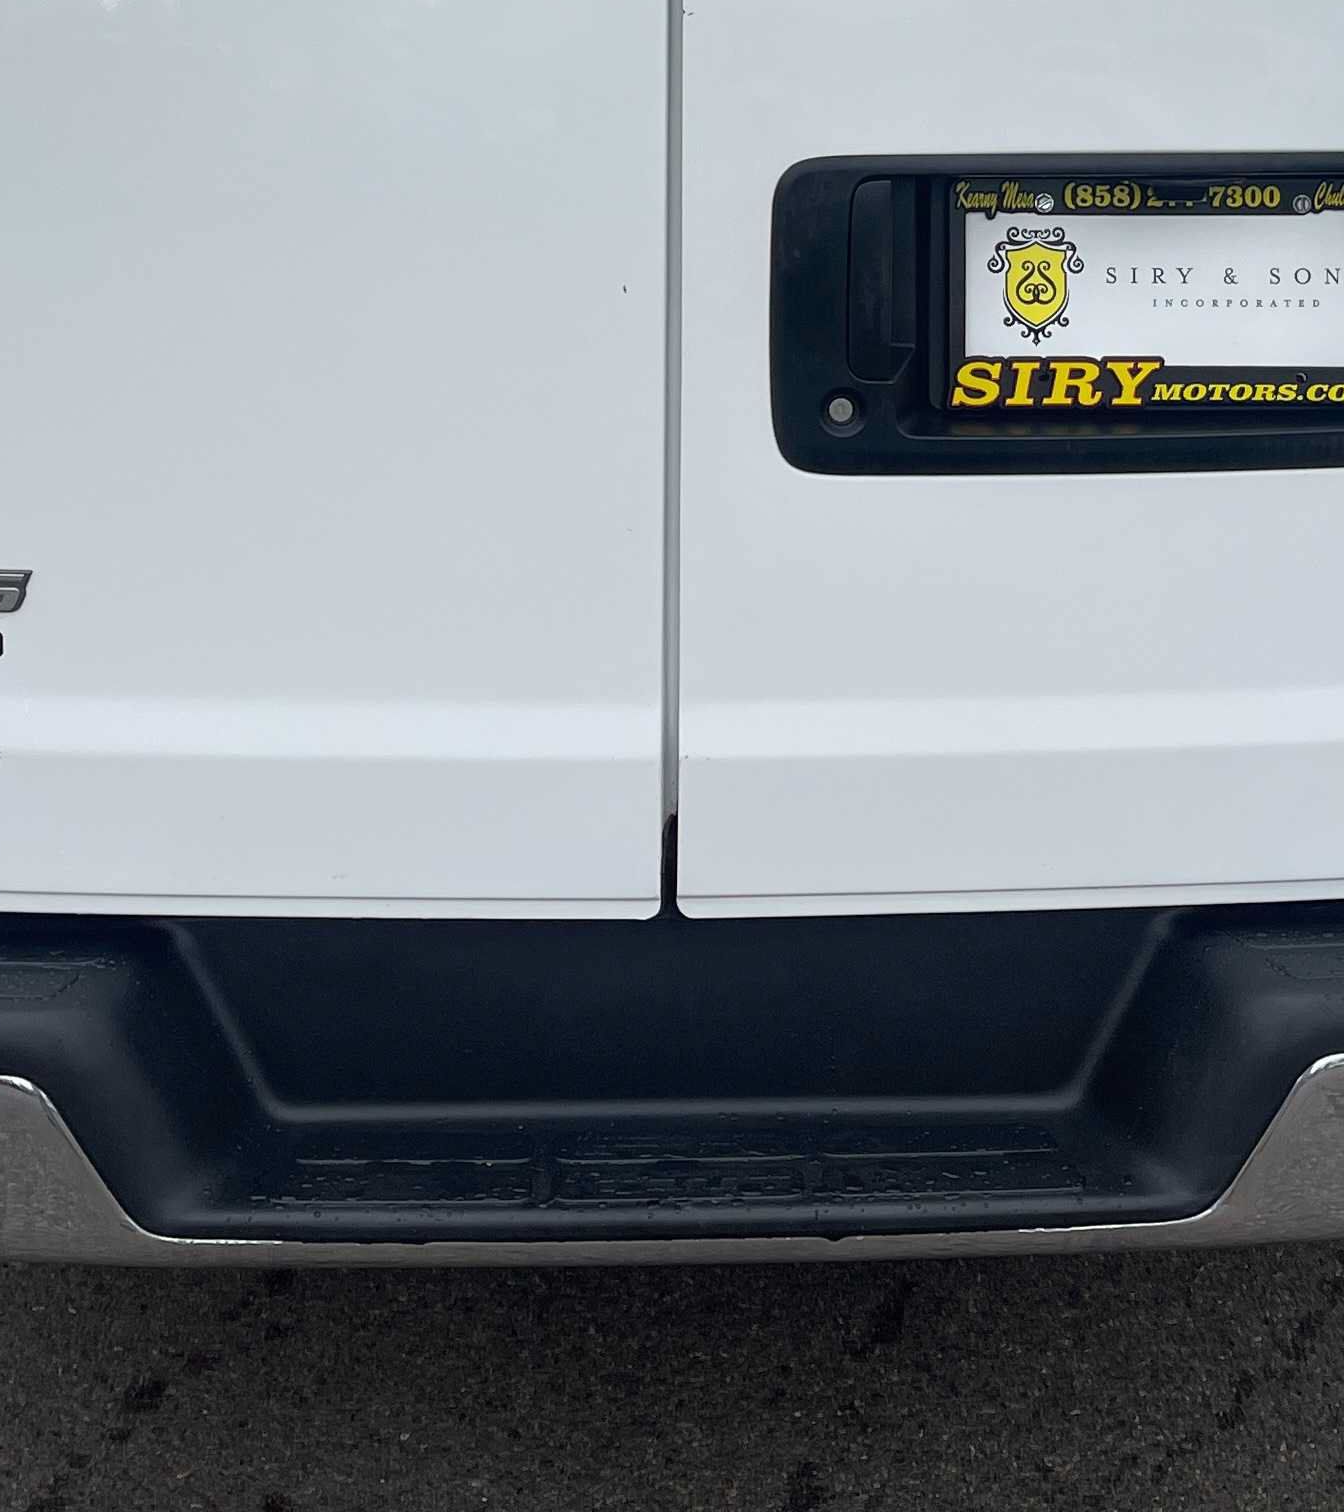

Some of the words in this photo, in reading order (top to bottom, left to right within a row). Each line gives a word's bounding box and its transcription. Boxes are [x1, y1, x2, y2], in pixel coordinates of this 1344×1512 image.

[956, 180, 999, 215] Kearny
[1001, 180, 1035, 210] Mesa
[1064, 182, 1142, 210] (858)
[1105, 266, 1195, 286] SIRY
[1222, 267, 1239, 286] &
[1152, 298, 1322, 309] INCORPORATED
